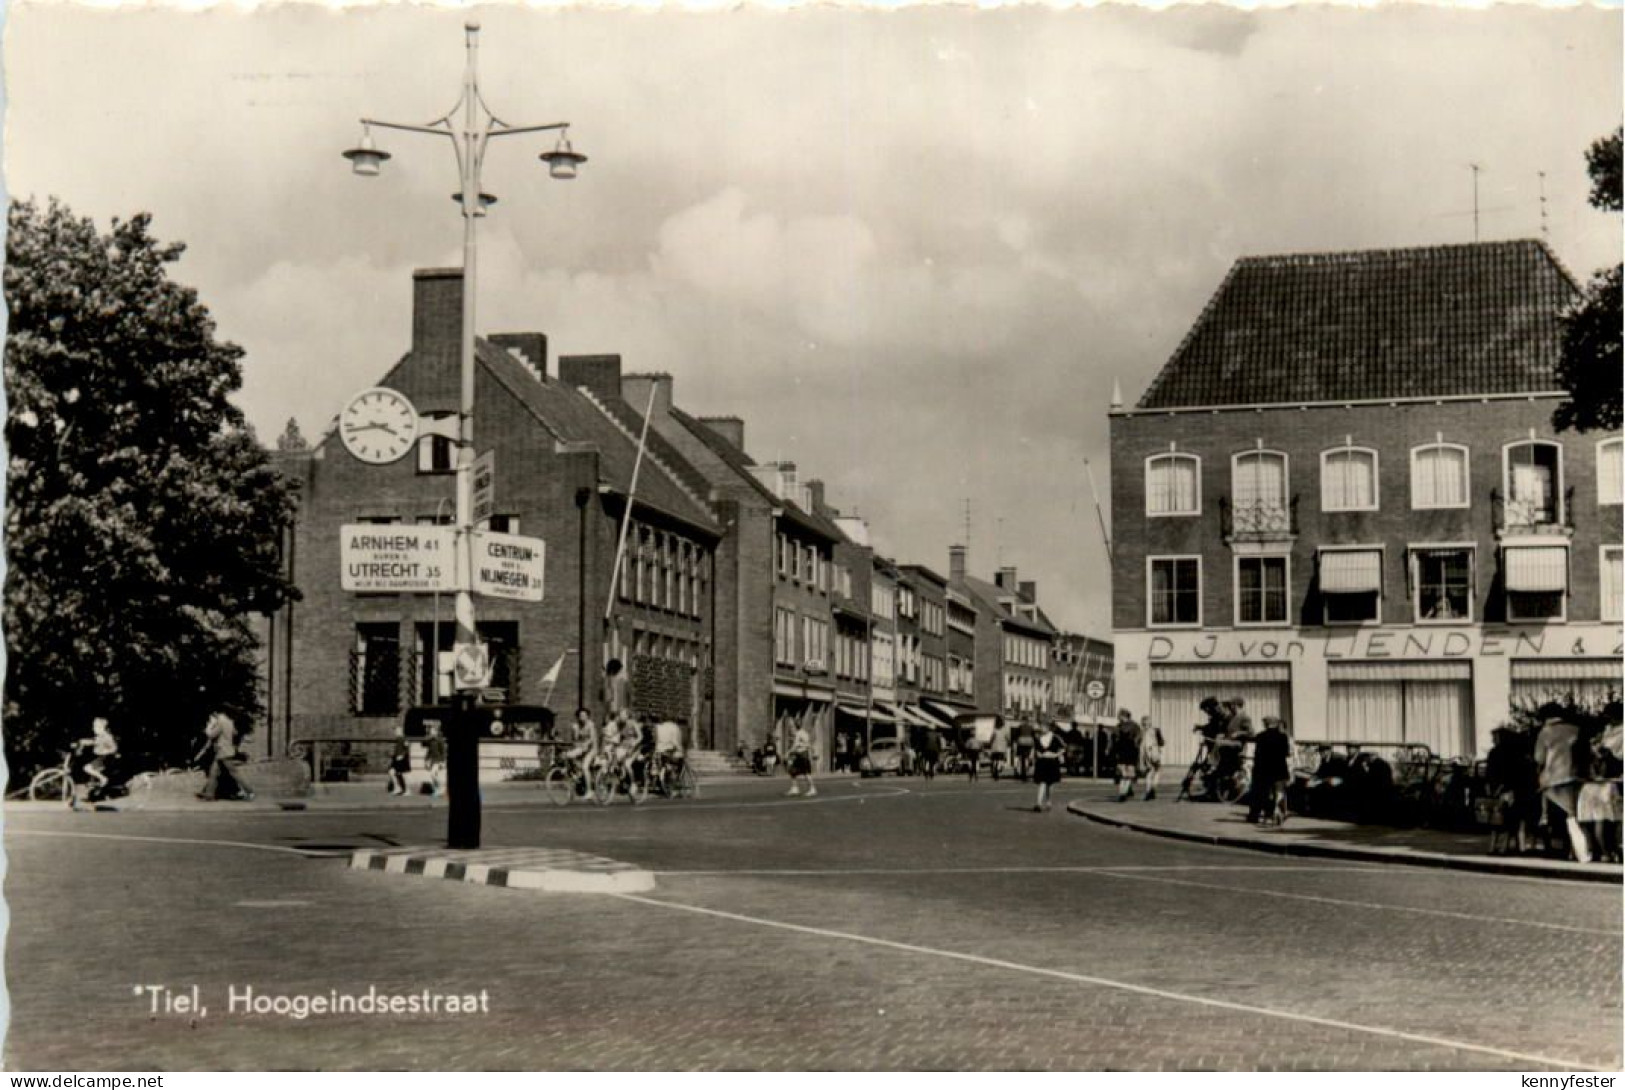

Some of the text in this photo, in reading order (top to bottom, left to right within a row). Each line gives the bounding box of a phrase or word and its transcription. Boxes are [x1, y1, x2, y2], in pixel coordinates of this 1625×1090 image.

[350, 535, 439, 551] ARNHEM 41
[349, 563, 420, 578] UTRECHT
[480, 567, 529, 588] NIJMEGEN
[1322, 630, 1546, 658] LIENDEN
